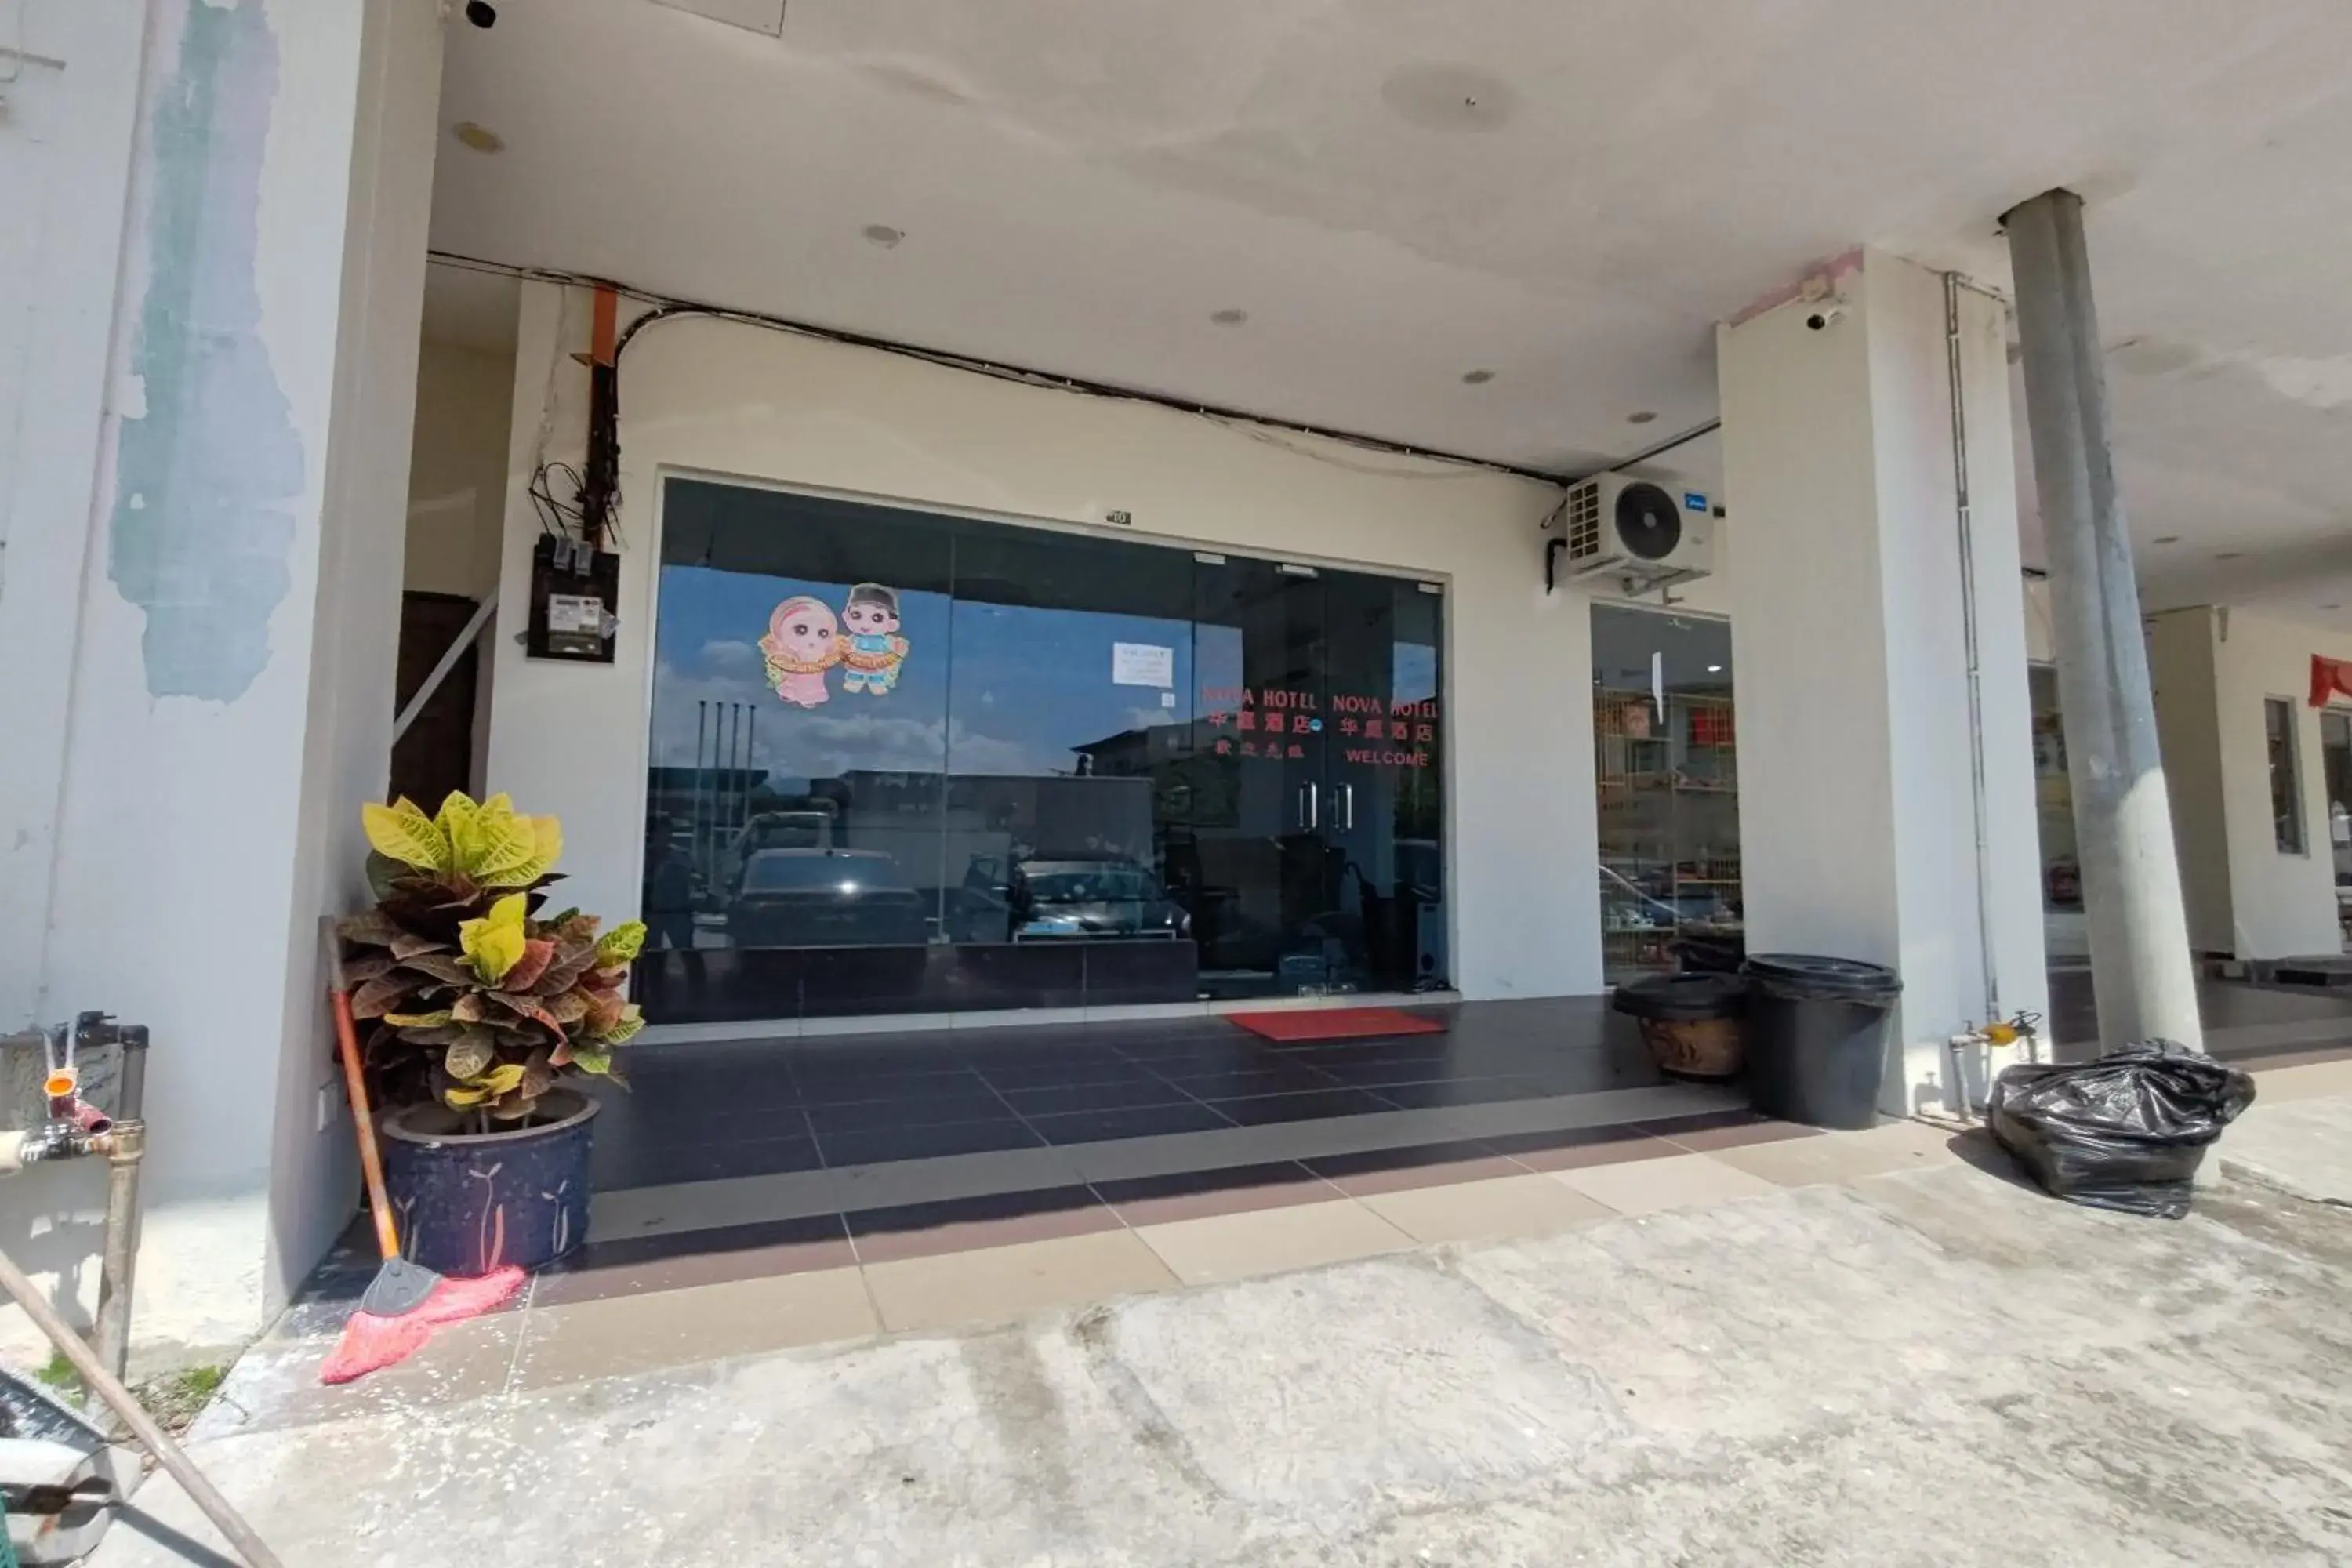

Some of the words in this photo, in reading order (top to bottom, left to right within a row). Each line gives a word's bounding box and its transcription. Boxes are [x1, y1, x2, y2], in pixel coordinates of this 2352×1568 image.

[1263, 690, 1317, 710] HOTEL
[1333, 695, 1382, 714] NOVA
[1345, 749, 1428, 767] WELCOME
